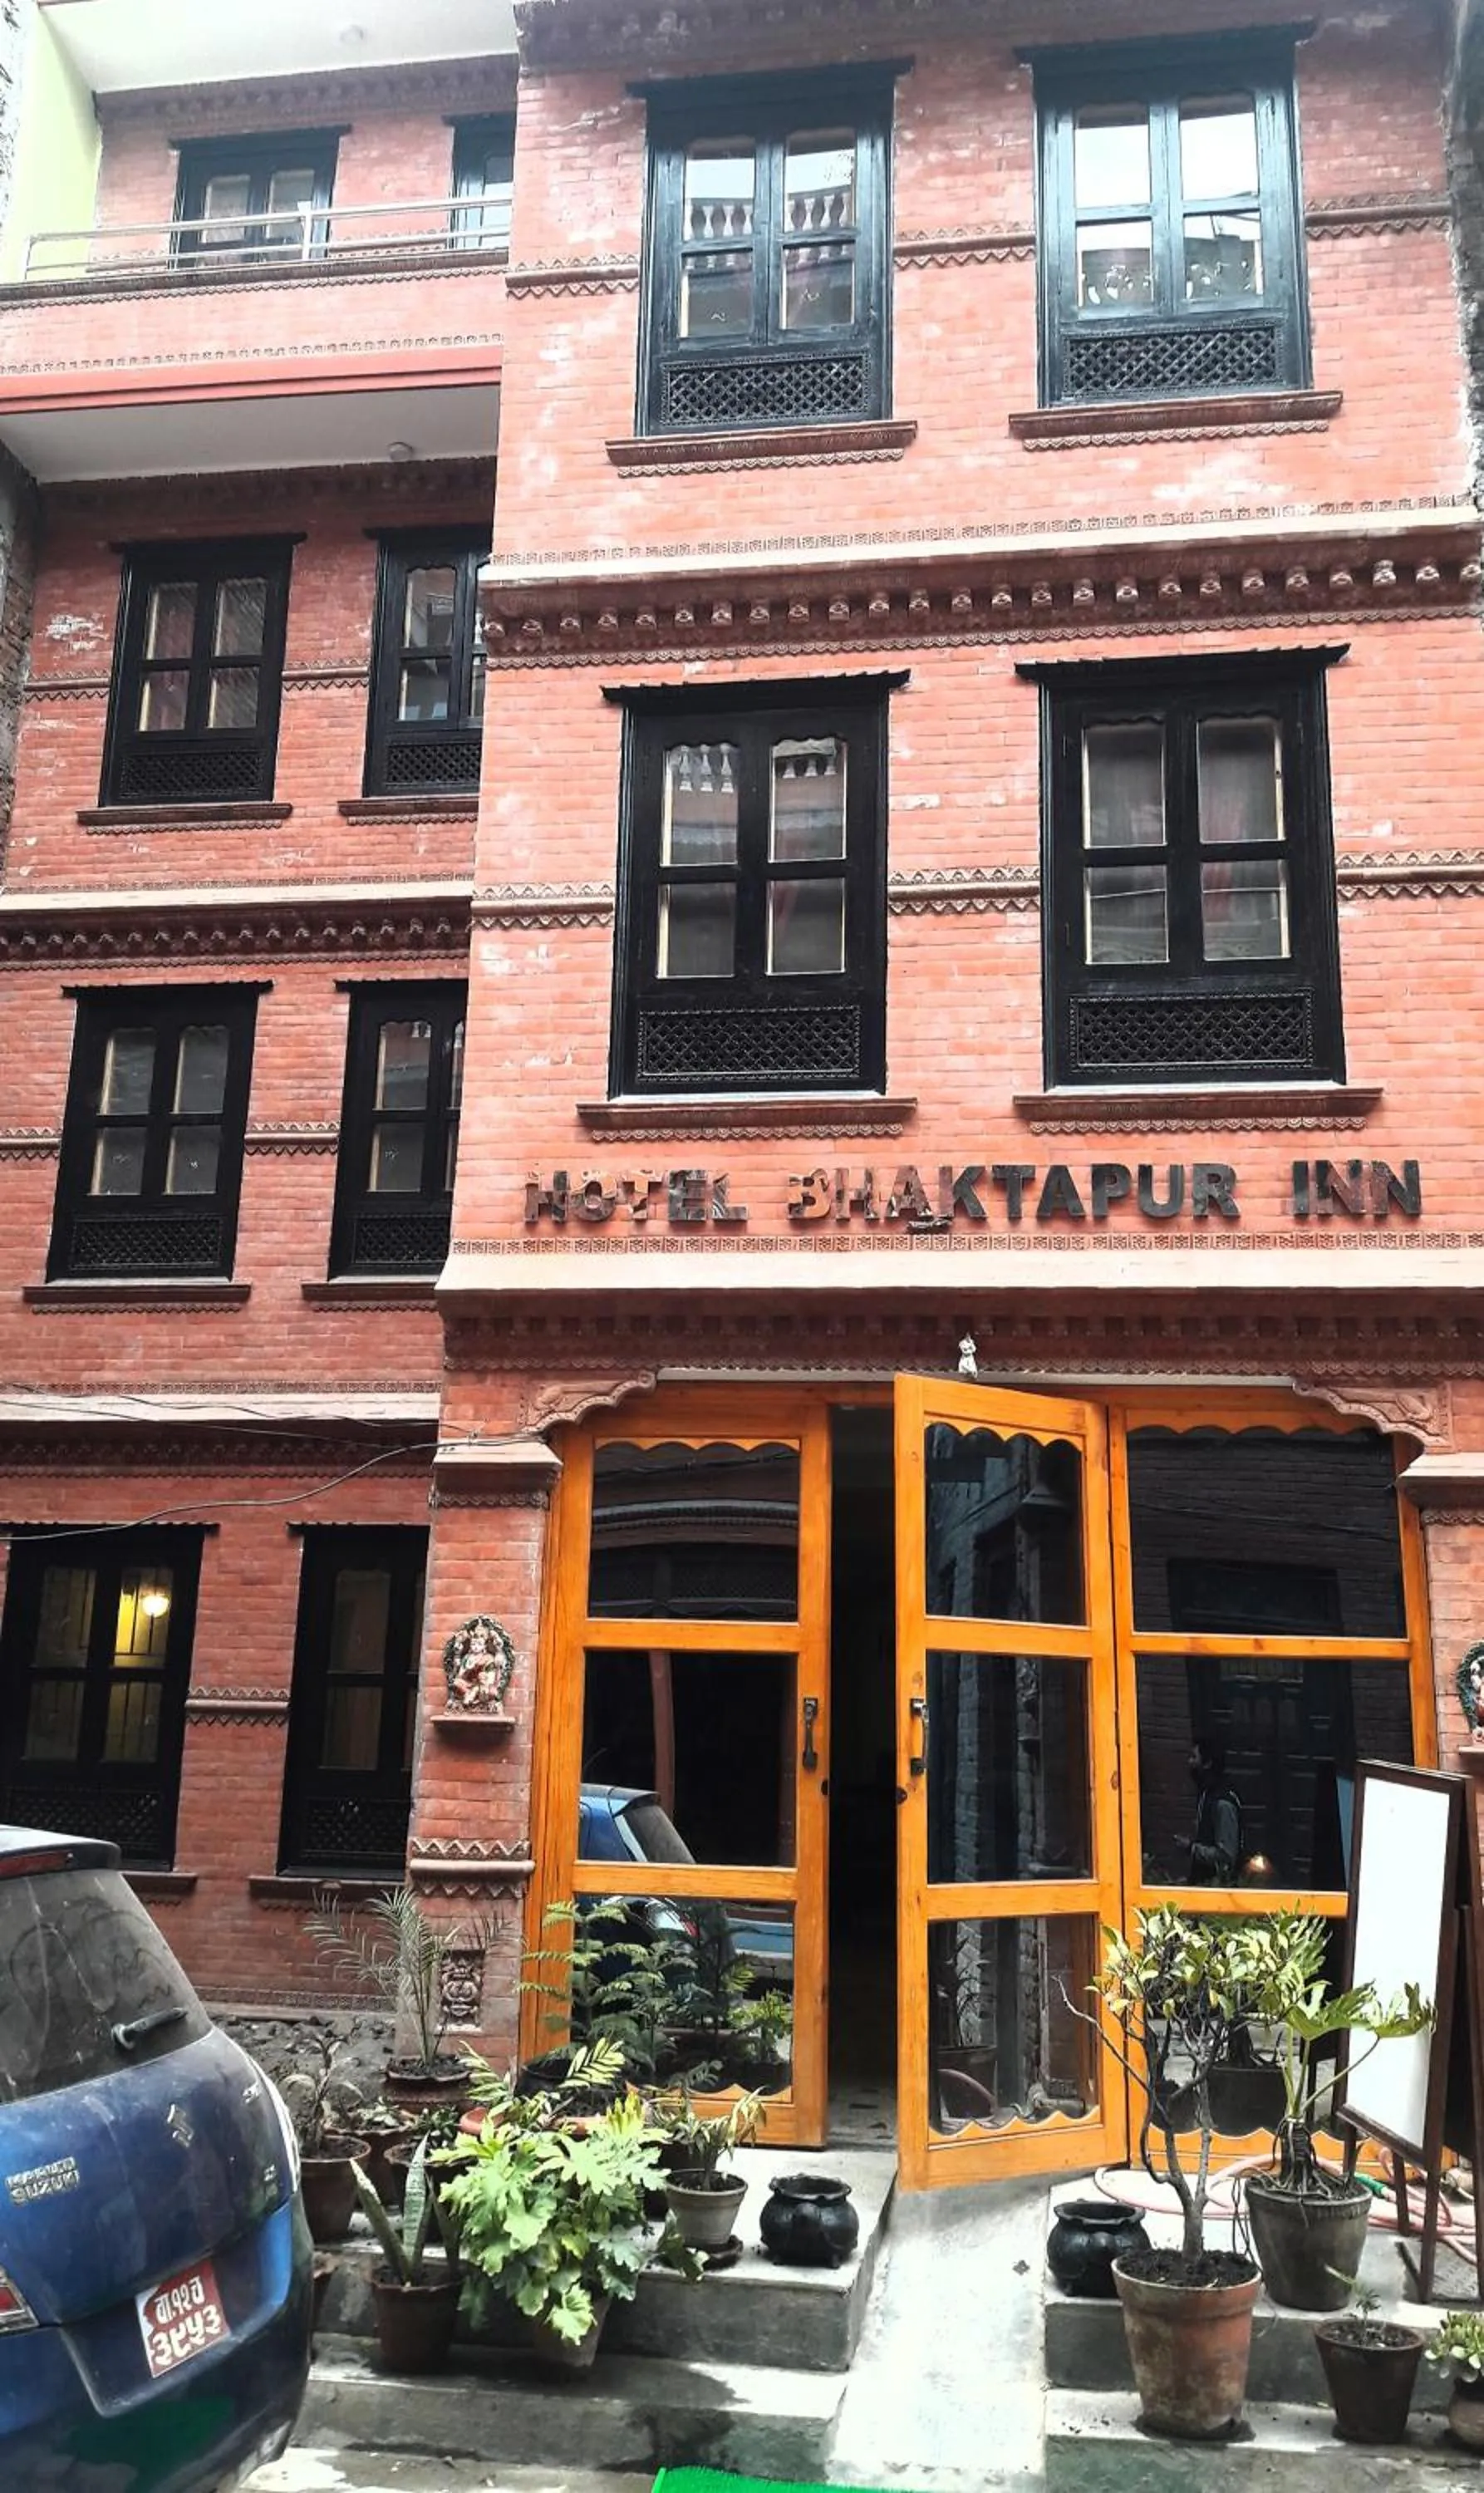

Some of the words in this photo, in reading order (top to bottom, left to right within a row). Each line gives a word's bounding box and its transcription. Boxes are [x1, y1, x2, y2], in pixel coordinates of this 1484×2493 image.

[524, 1168, 747, 1222] HOTEL
[786, 1163, 1241, 1222] BHAKTAPUR
[1291, 1159, 1422, 1218] INN
